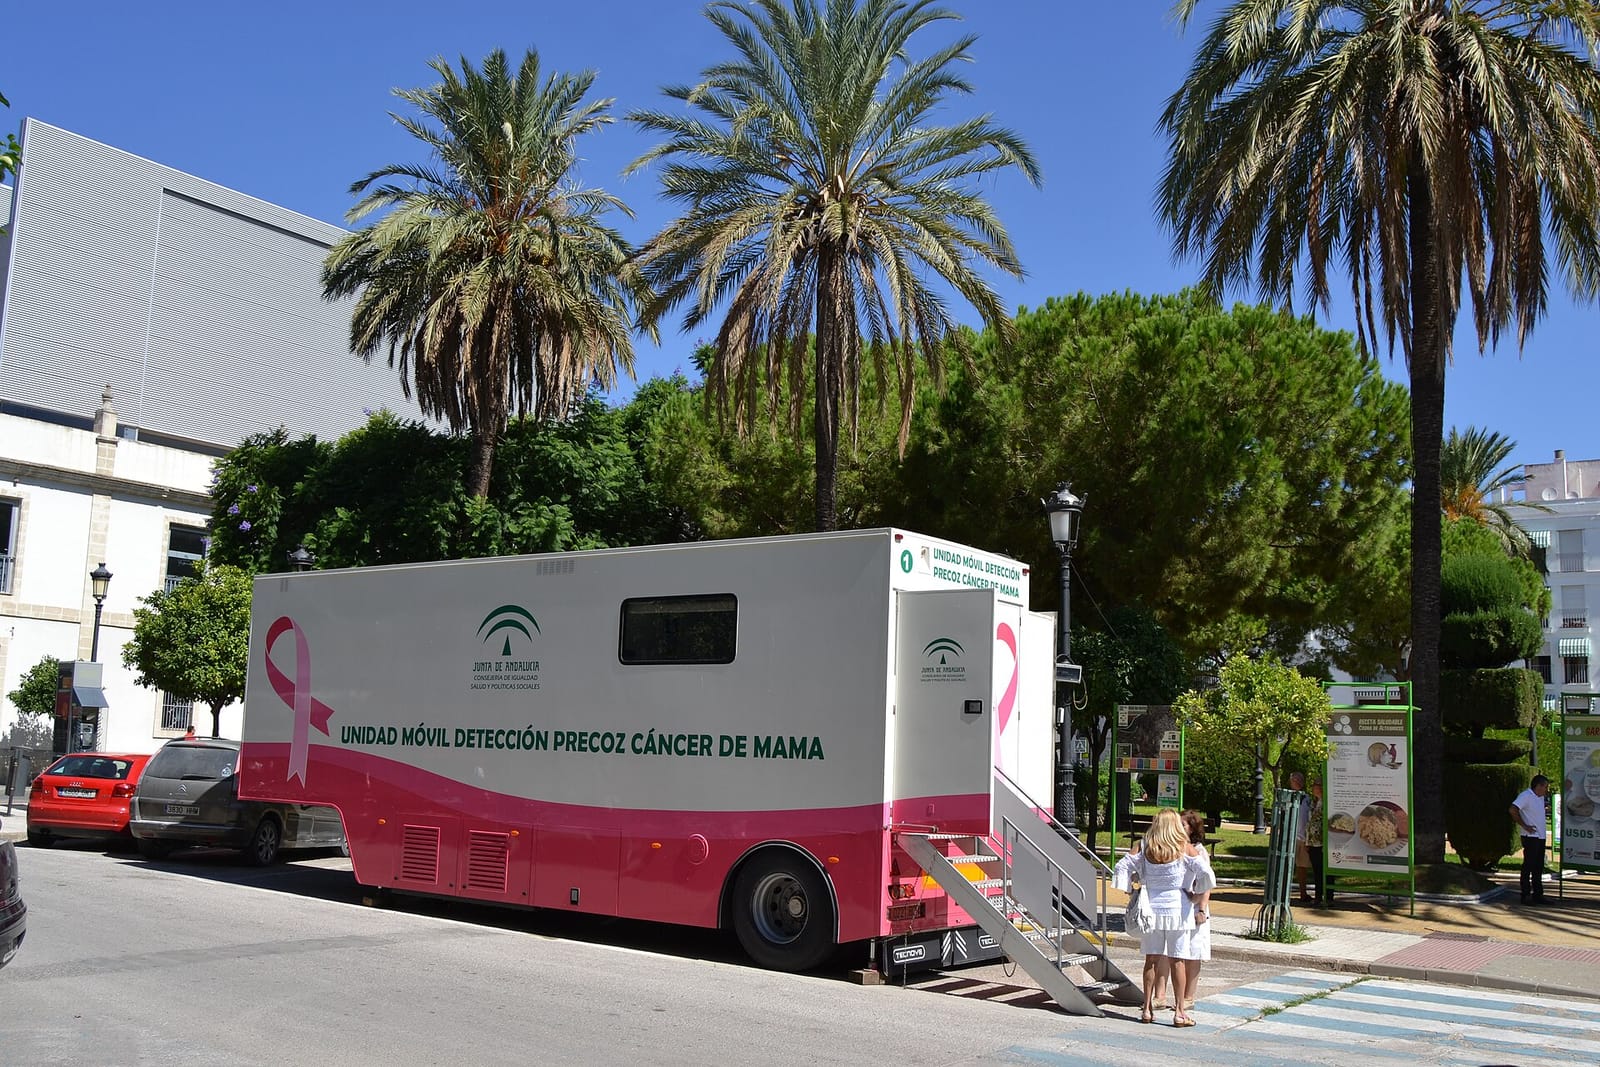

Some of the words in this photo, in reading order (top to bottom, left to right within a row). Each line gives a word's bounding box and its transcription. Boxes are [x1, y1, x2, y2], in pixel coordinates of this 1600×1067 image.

[933, 548, 961, 565] UNIDAD
[962, 555, 984, 572] MÓVIL
[985, 562, 1020, 581] DETECCIÓN
[933, 566, 961, 584] PRECOZ
[962, 573, 989, 589] CÁNCER
[1000, 583, 1020, 598] MAMA
[473, 661, 492, 672] JUNTA
[495, 661, 503, 672] DE
[340, 725, 398, 746] UNIDAD
[401, 722, 450, 748] MÓVIL
[454, 724, 549, 751] DETECCIÓN
[553, 731, 626, 754] PRECOZ
[631, 728, 713, 757] CÁNCER
[719, 735, 748, 758] DE
[753, 735, 825, 760] MAMA
[1565, 828, 1594, 838] USOS
